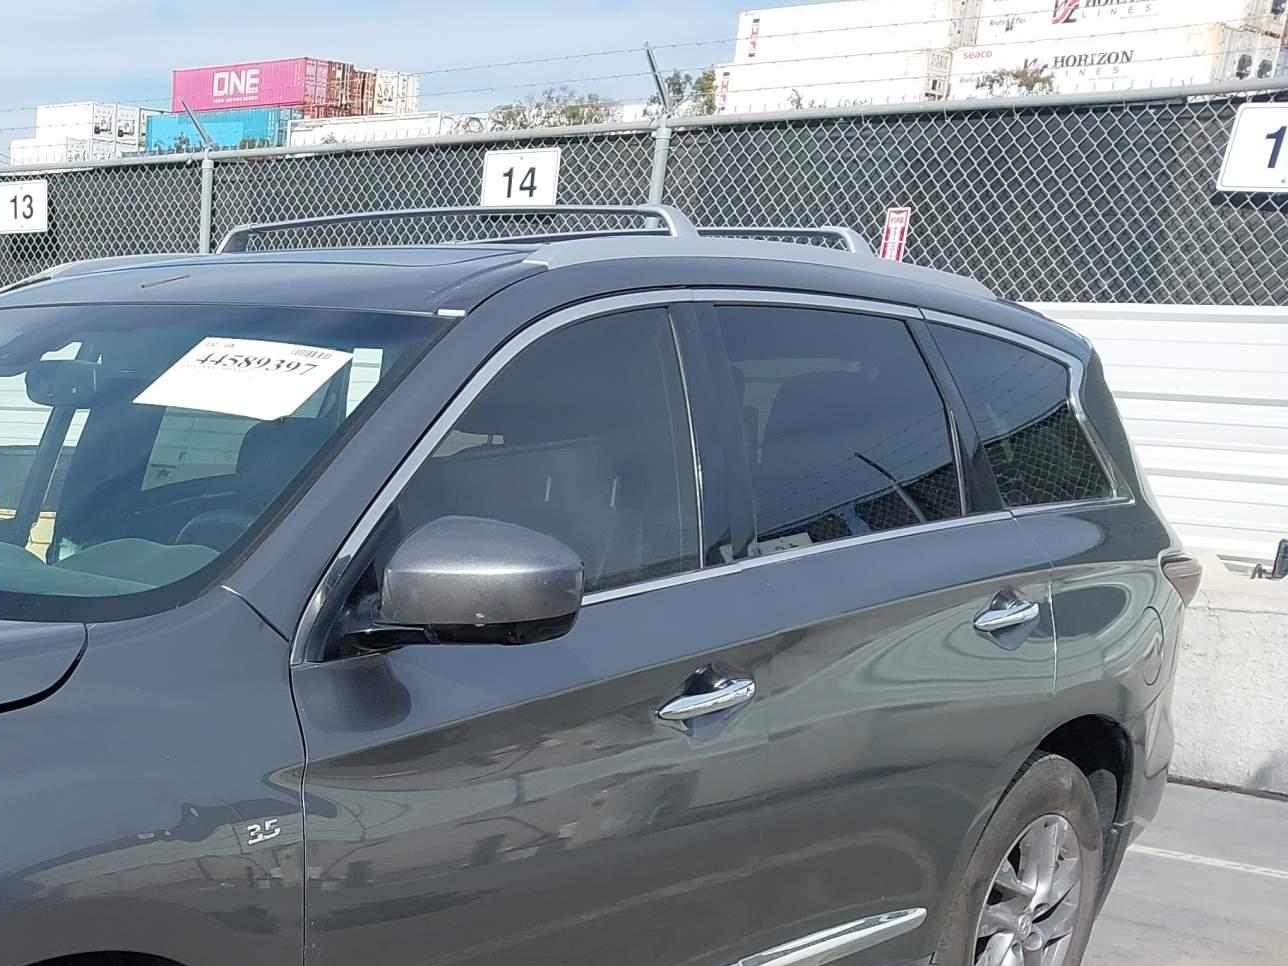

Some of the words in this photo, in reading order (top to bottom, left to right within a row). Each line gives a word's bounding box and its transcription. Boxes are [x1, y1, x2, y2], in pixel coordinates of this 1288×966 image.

[963, 50, 993, 59] seaco
[1052, 50, 1135, 68] HORIZON
[213, 69, 259, 96] ONE
[1265, 126, 1288, 168] 1
[503, 166, 537, 198] 14
[10, 194, 34, 219] 13
[196, 351, 319, 376] 44589397
